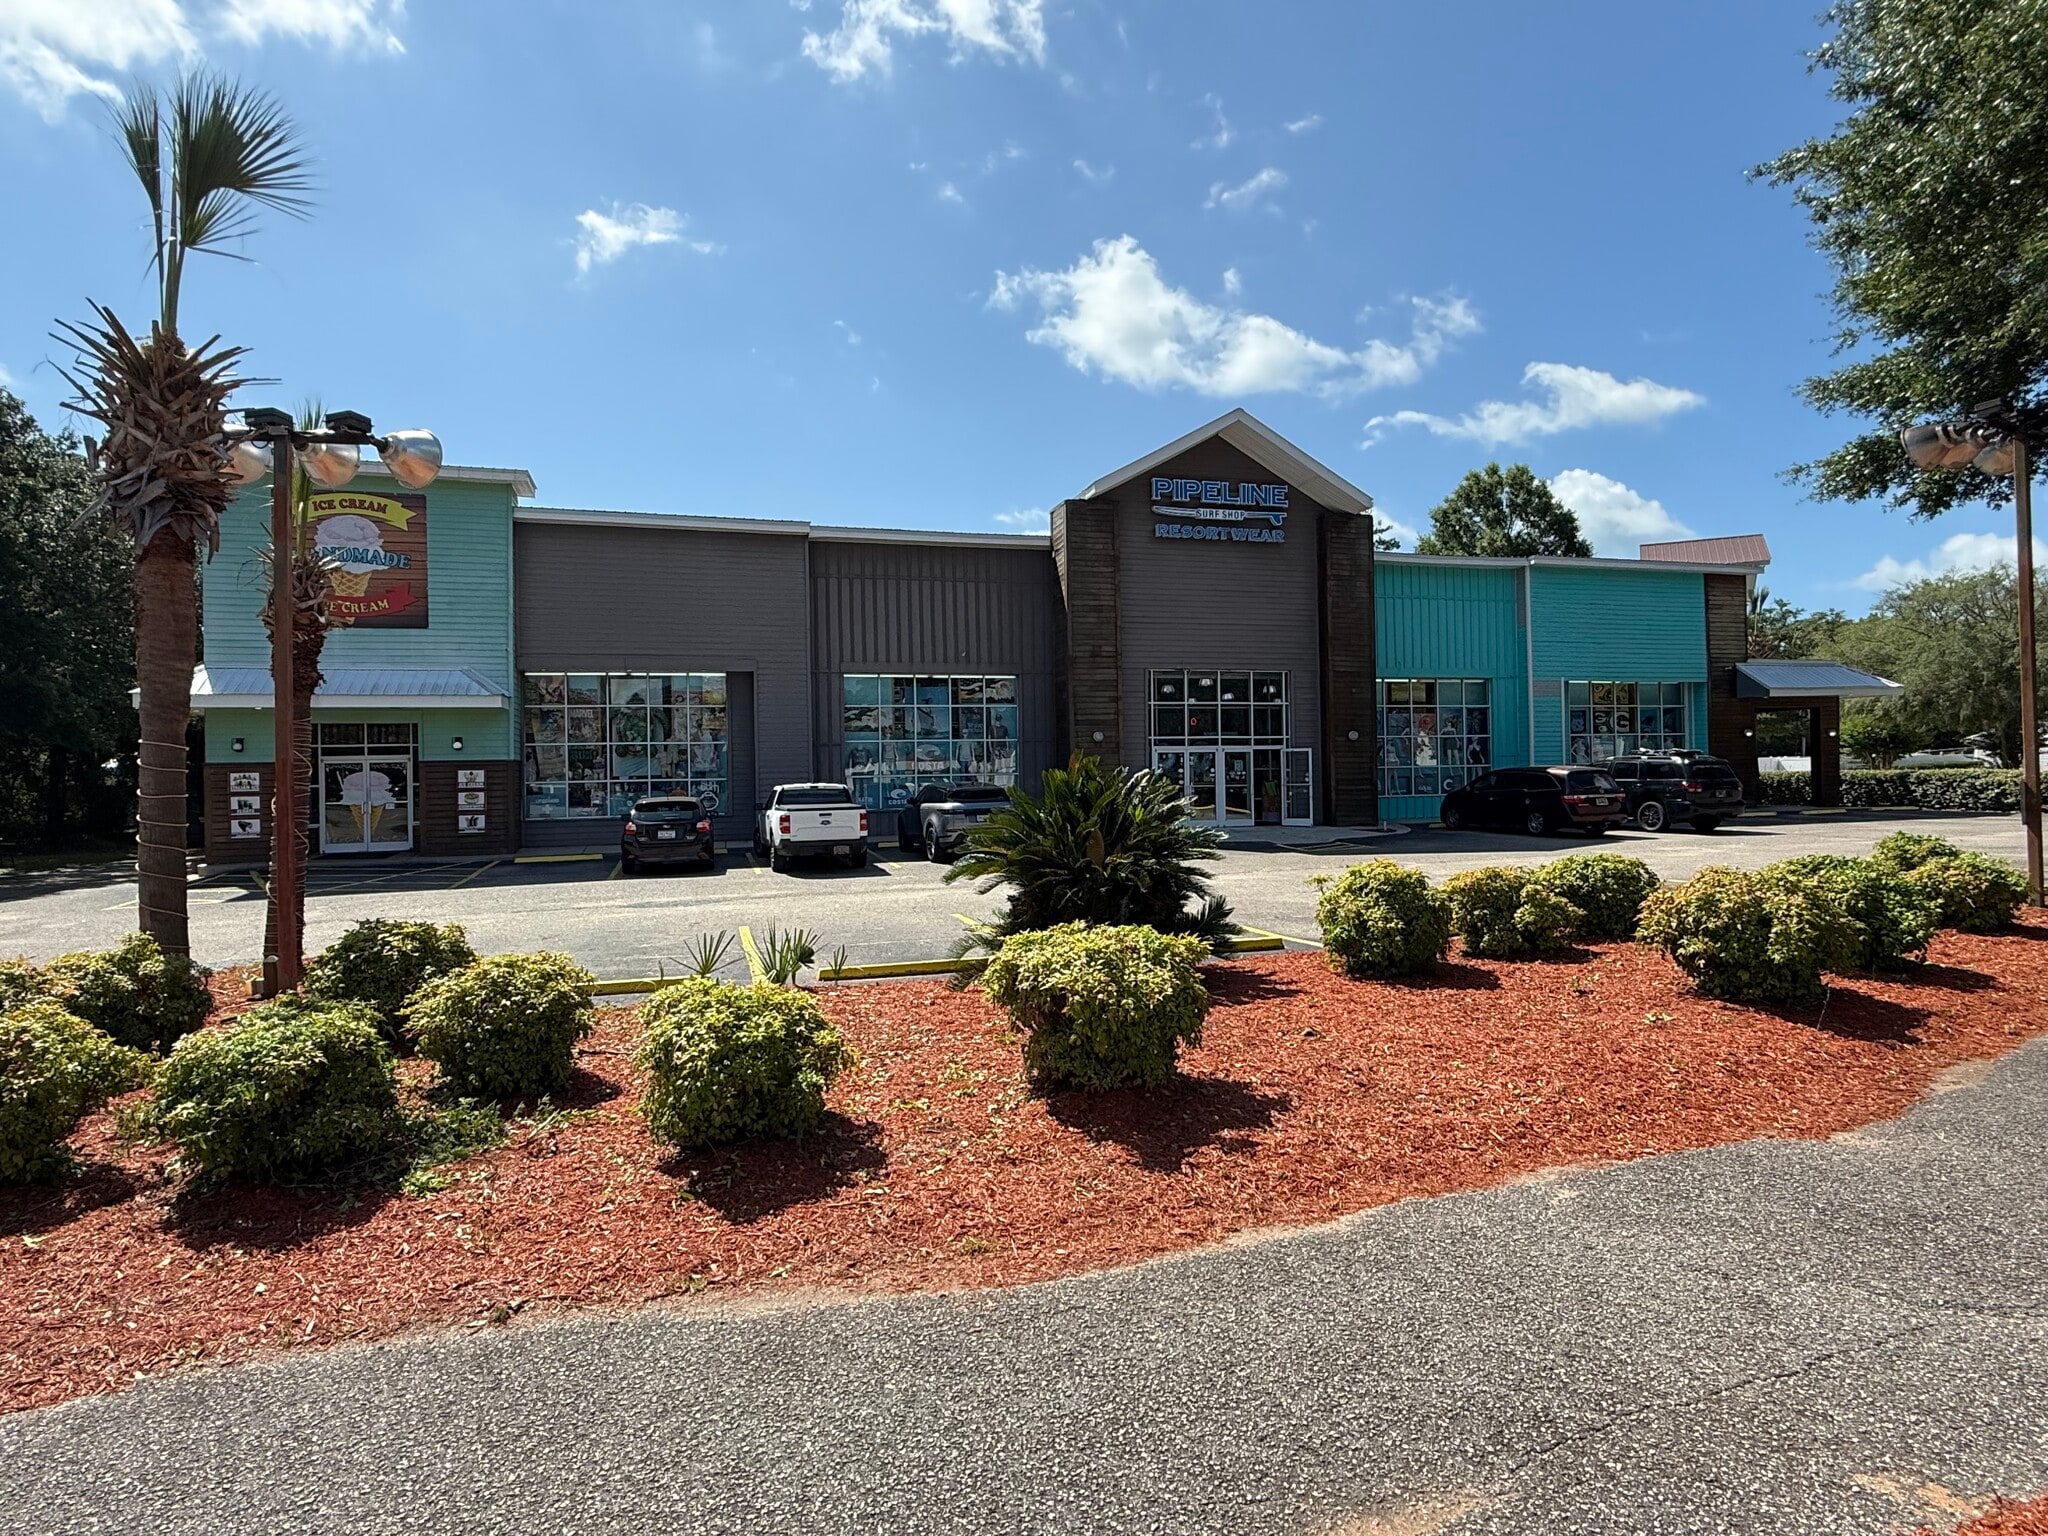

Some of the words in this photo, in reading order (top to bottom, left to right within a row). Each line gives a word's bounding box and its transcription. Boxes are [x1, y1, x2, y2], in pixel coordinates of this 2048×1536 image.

[1151, 477, 1288, 507] PIPELINE
[312, 500, 336, 511] ICE
[339, 498, 388, 513] CREAM
[1196, 509, 1220, 518] SURF
[1222, 510, 1245, 519] SHOP
[1155, 524, 1231, 540] RESORT
[1231, 528, 1285, 543] WEAR
[320, 547, 411, 569] NDMADE
[341, 599, 389, 613] CREAM
